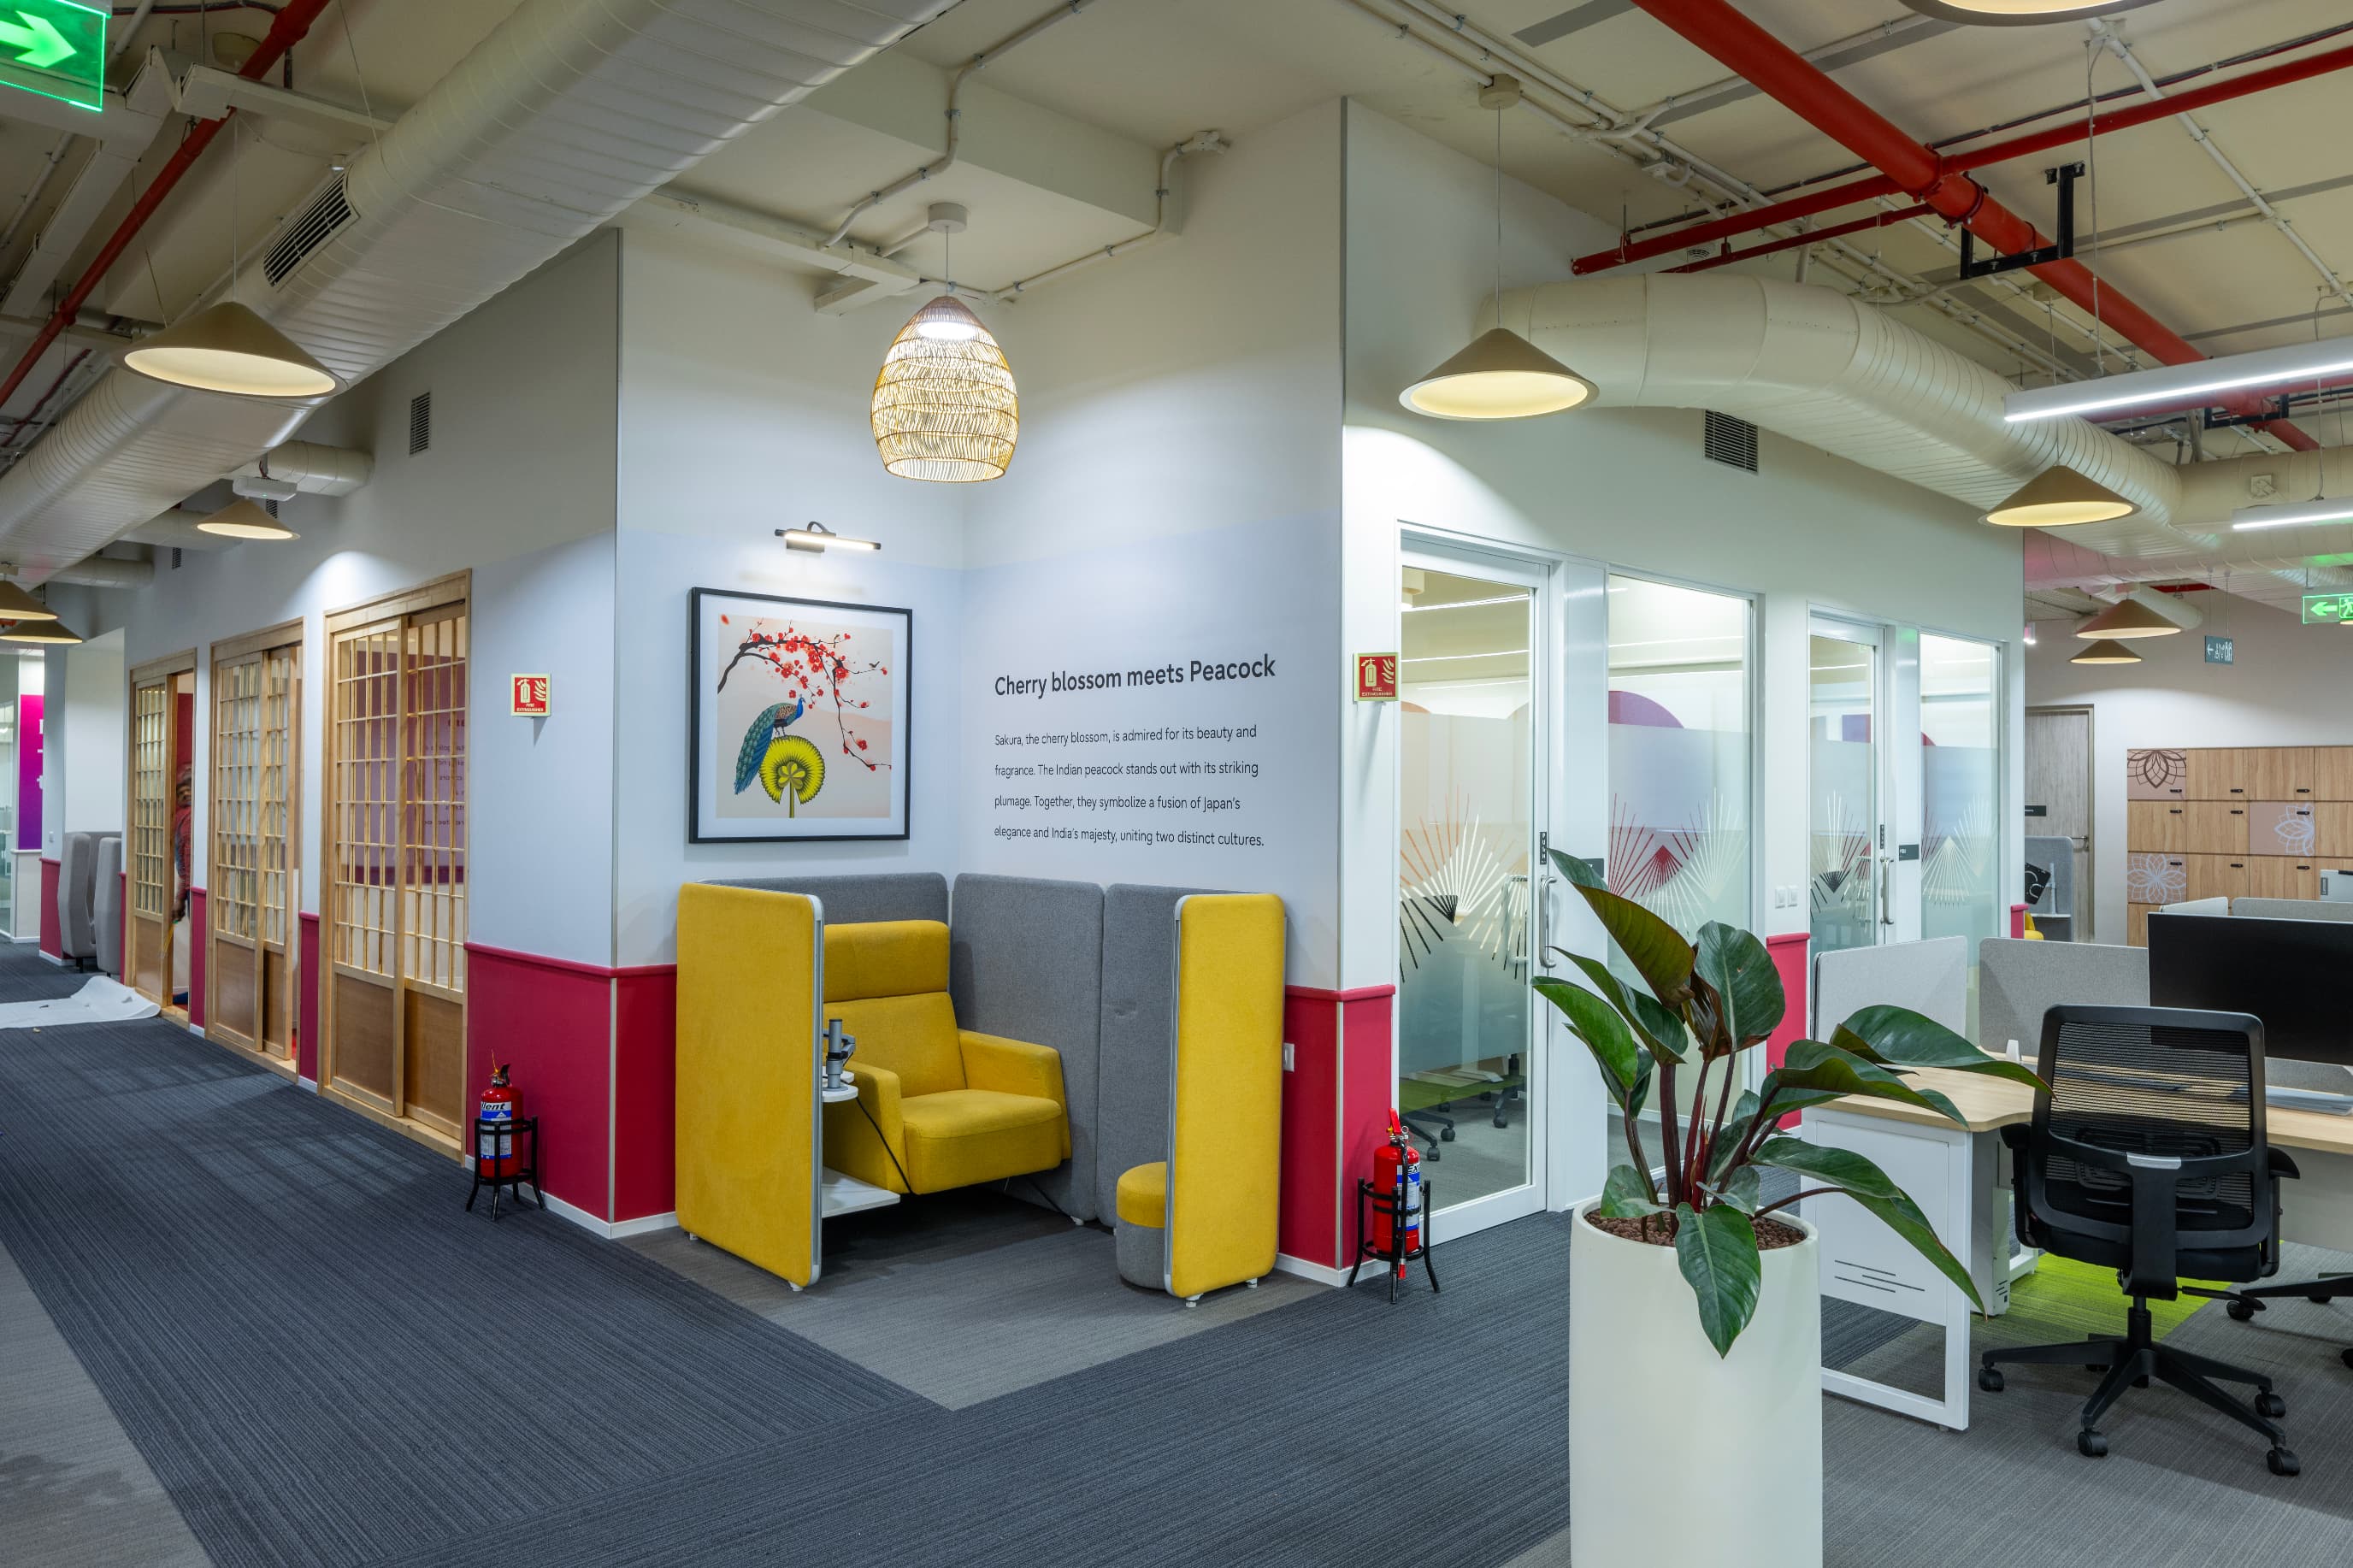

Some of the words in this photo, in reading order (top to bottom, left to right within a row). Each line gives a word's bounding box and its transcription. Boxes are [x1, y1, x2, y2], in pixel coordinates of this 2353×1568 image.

[994, 674, 1047, 700] Cherry
[1051, 669, 1122, 693] blossom
[1127, 663, 1184, 687] meets
[1189, 652, 1277, 682] Peacock
[994, 734, 1023, 746] Sakura,
[1025, 732, 1040, 746] the
[1041, 732, 1069, 747] cherry
[1070, 731, 1111, 745] blossom,
[1112, 729, 1120, 743] is
[1122, 727, 1164, 742] admired
[1164, 727, 1181, 741] for
[1182, 726, 1194, 740] its
[1196, 726, 1234, 743] beauty
[1235, 723, 1257, 740] and
[994, 763, 1036, 781] fragrance.
[1036, 763, 1054, 778] The
[1056, 763, 1082, 779] Indian
[1084, 762, 1124, 779] peacock
[1125, 761, 1158, 775] stands
[1159, 762, 1177, 775] out
[1178, 760, 1201, 775] with
[1204, 761, 1217, 775] its
[1218, 759, 1259, 778] striking
[994, 794, 1033, 811] plumage.
[1033, 794, 1075, 811] Together,
[1076, 794, 1098, 811] they
[1099, 795, 1147, 811] symbolize
[1148, 799, 1155, 809] a
[1156, 794, 1188, 810] fusion
[1189, 795, 1202, 810] of
[1201, 795, 1241, 813] Japan's
[994, 824, 1032, 840] elegance
[1033, 826, 1050, 840] and
[1052, 827, 1079, 840] India's
[1081, 827, 1118, 845] majesty,
[1120, 828, 1153, 846] uniting
[1155, 830, 1175, 843] two
[1176, 829, 1216, 846] distinct
[1218, 831, 1265, 847] cultures.
